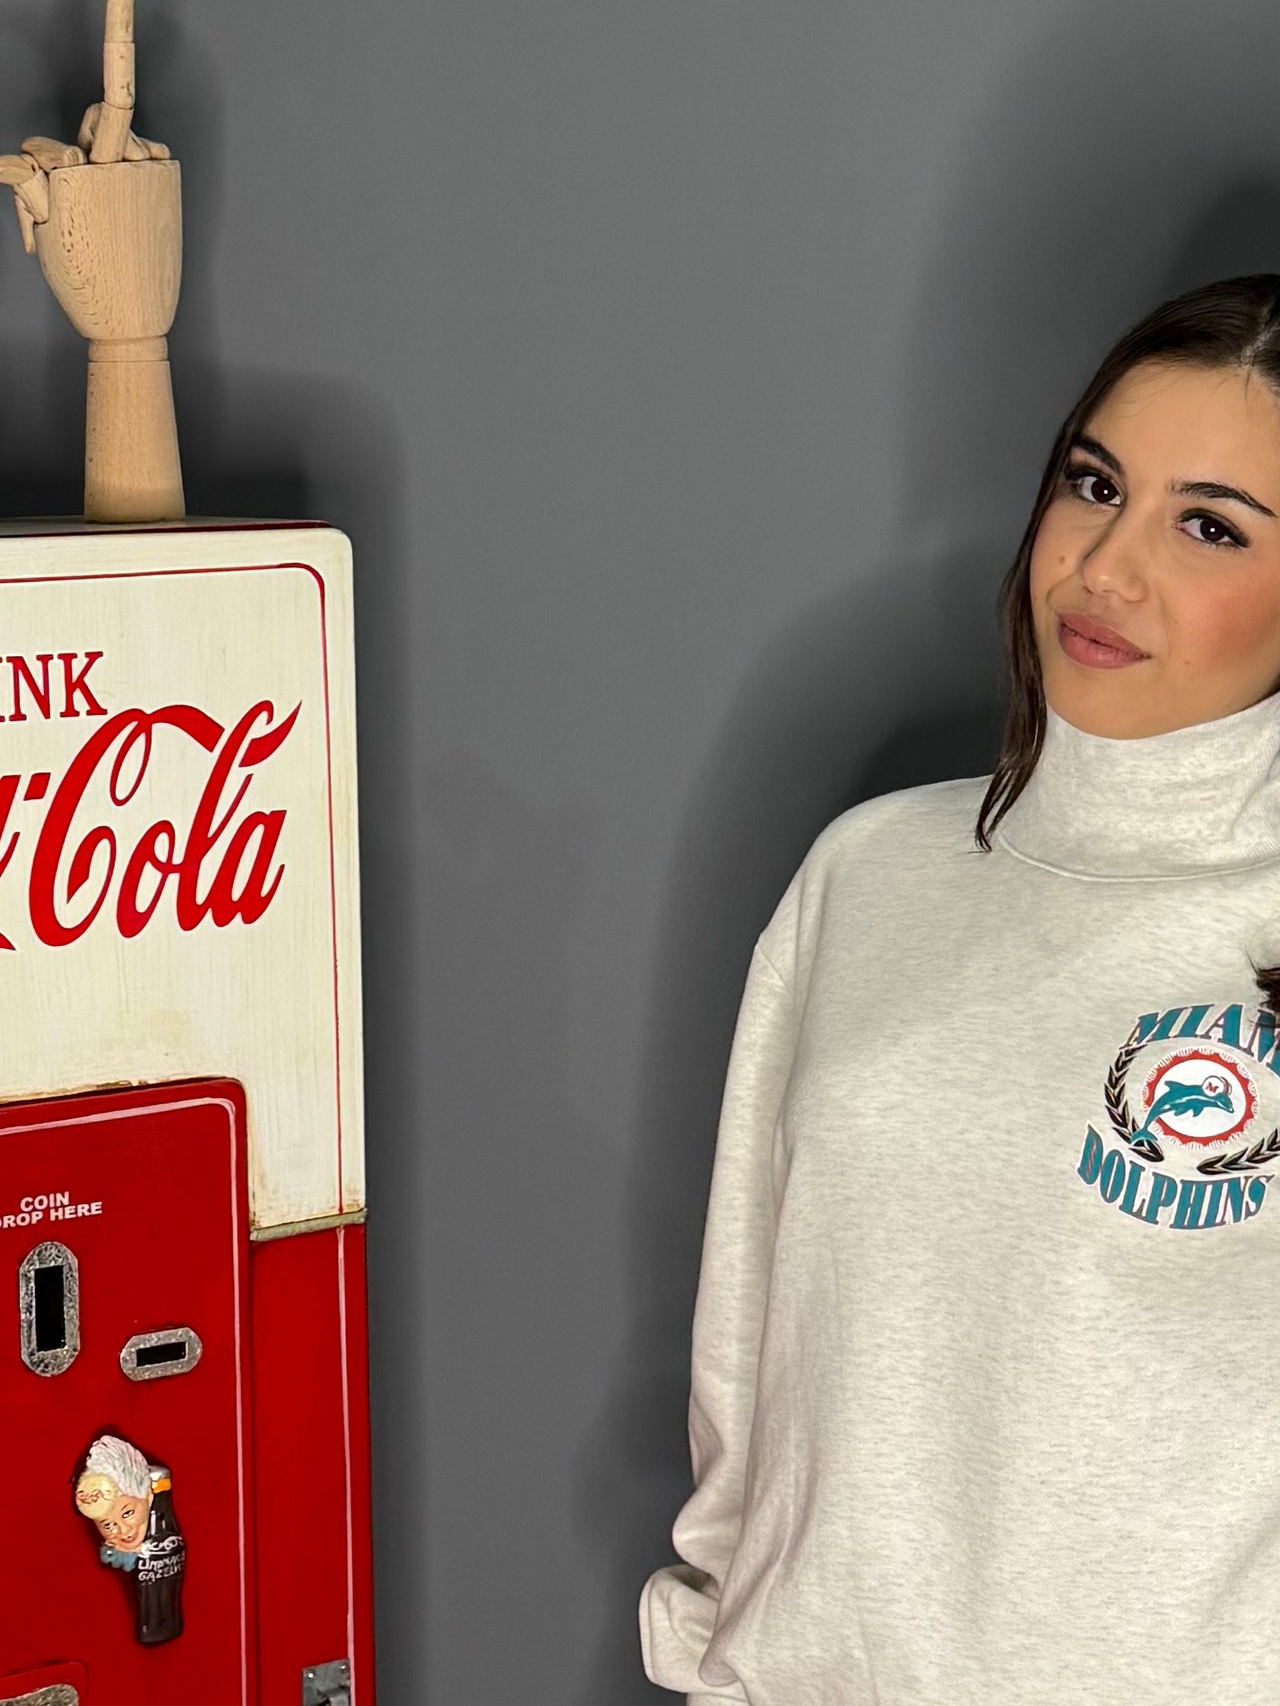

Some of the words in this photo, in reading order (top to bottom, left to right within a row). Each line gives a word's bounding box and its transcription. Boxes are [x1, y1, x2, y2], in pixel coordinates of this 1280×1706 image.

[1077, 1124, 1276, 1230] DOLPHINS
[19, 1191, 70, 1213] COIN
[49, 1201, 103, 1223] HERE
